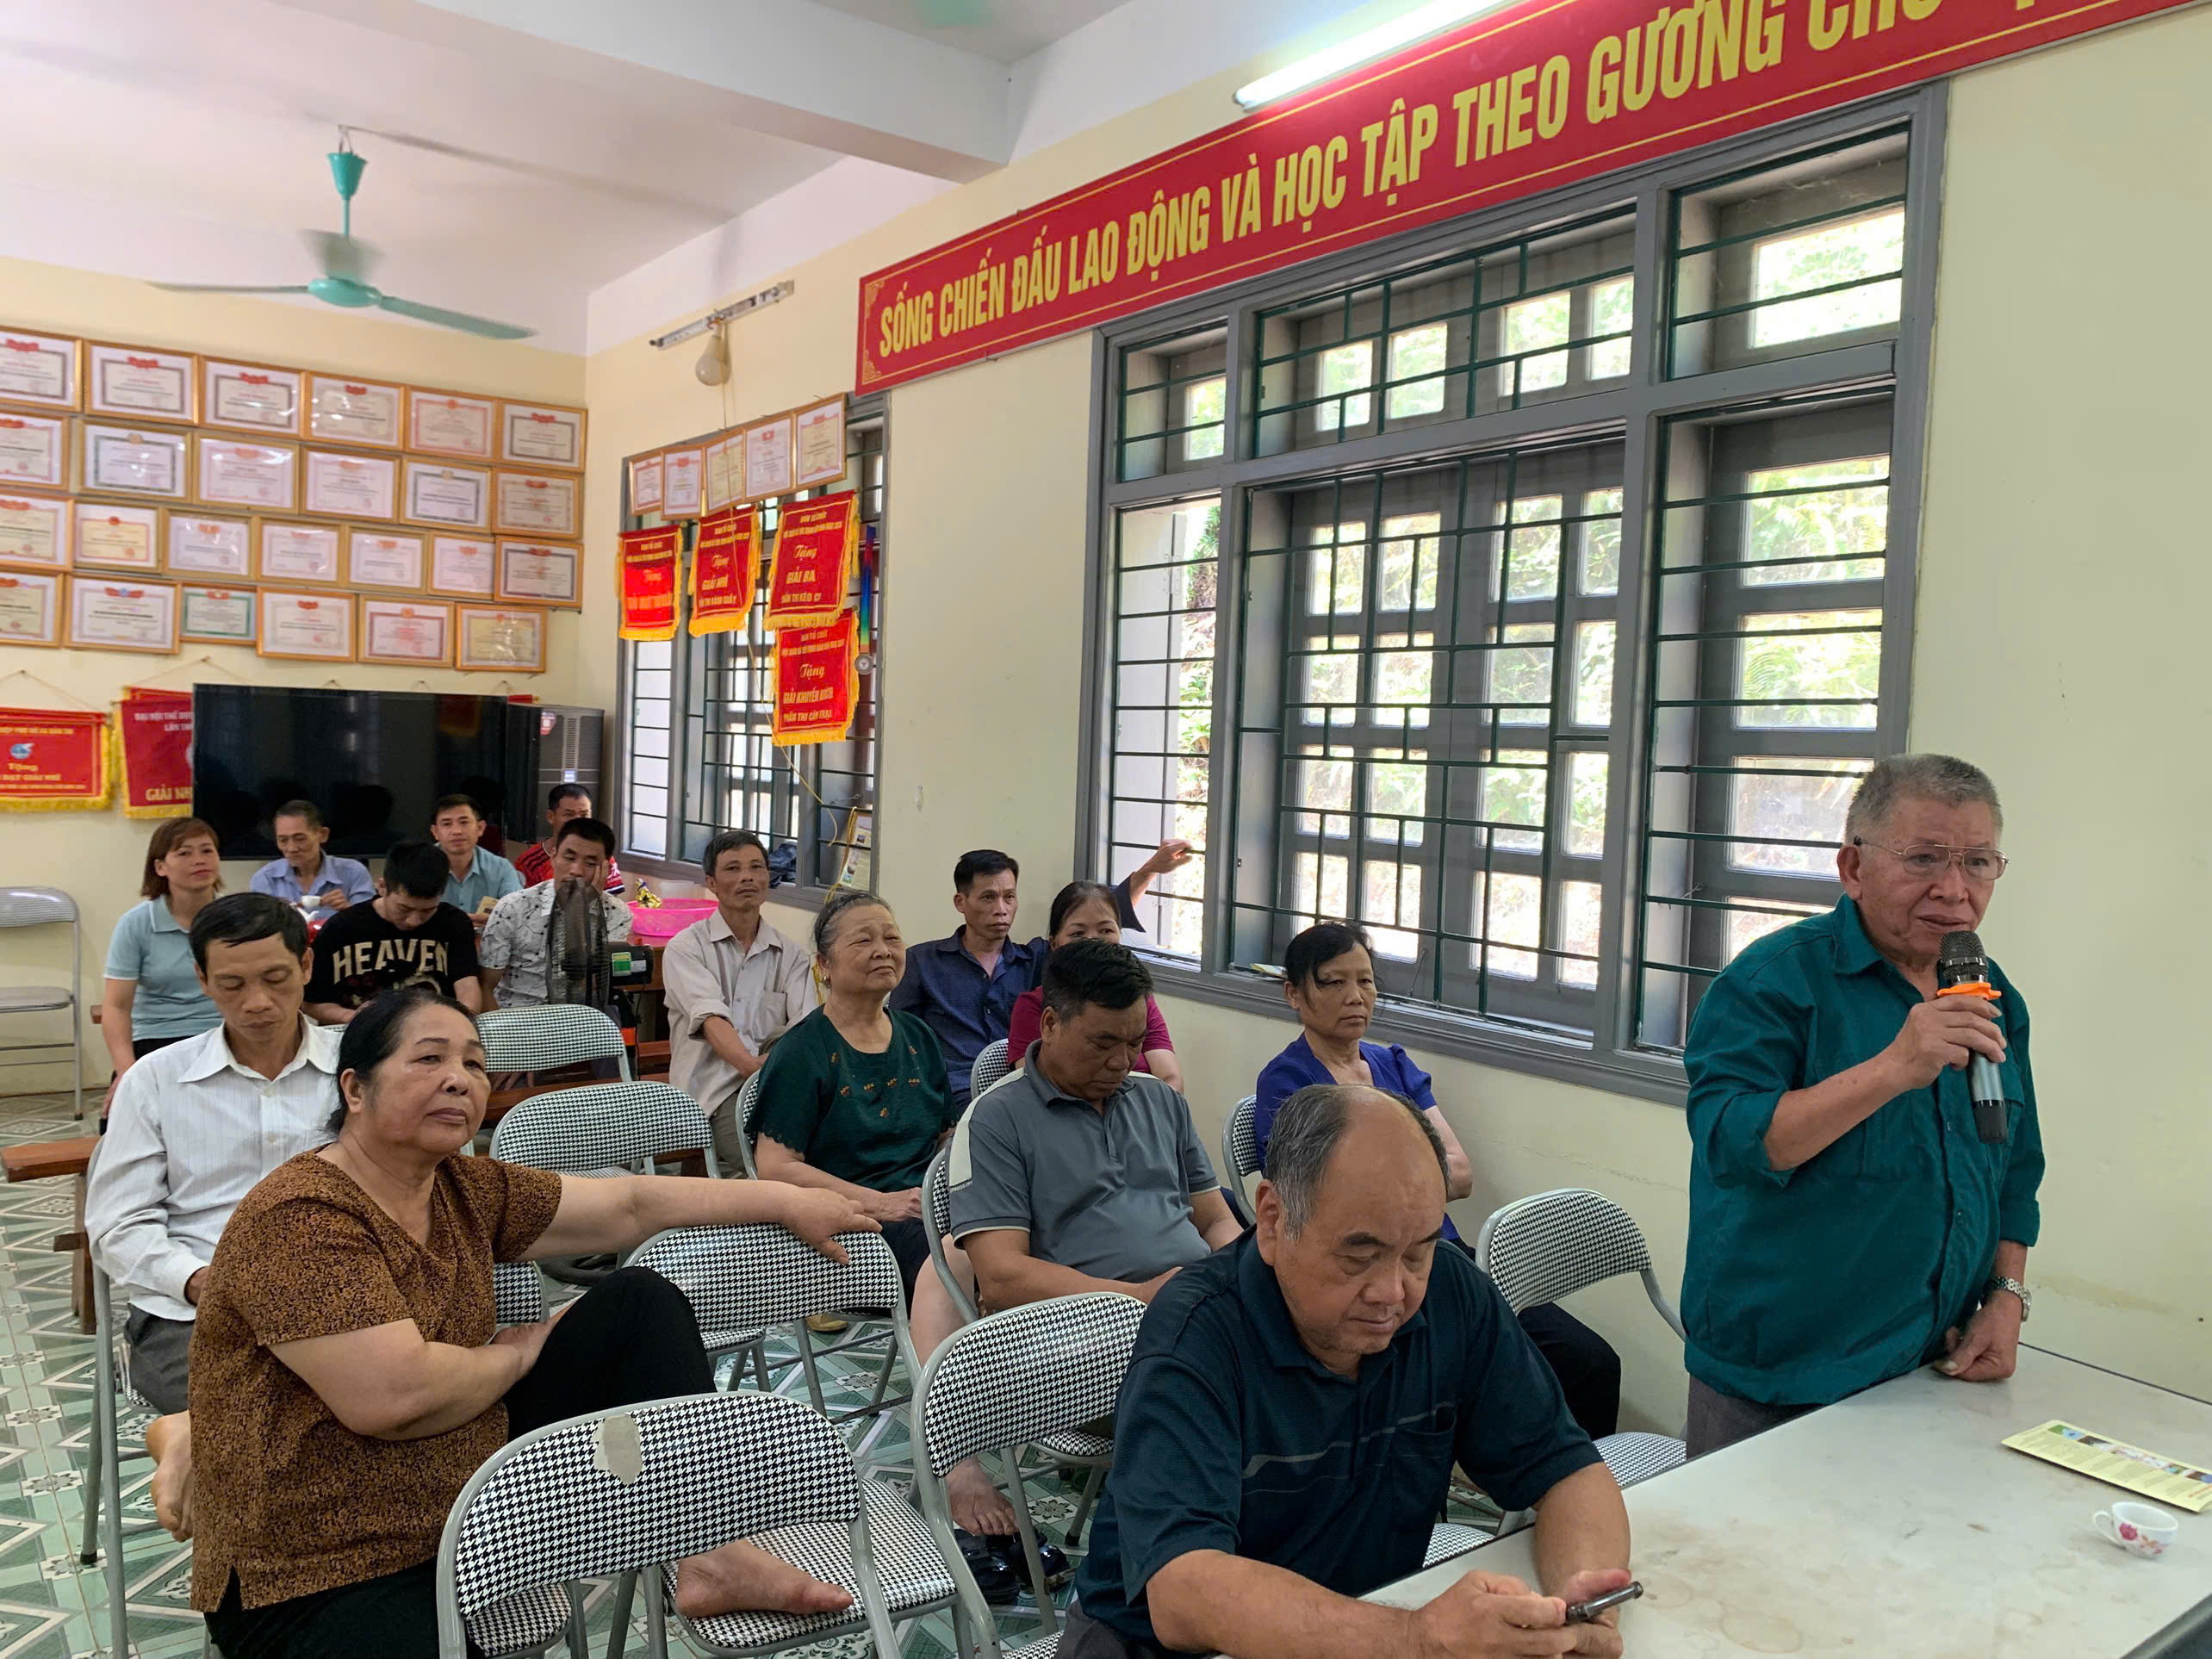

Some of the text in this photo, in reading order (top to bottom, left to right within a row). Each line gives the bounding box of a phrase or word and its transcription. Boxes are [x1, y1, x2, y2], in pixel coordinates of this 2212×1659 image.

[879, 282, 934, 357] SỐNG
[939, 247, 1006, 337] CHIẾN
[1011, 225, 1062, 314] ĐẤU
[1068, 221, 1120, 295] LAO
[1127, 189, 1210, 282] ĐỘNG
[1221, 152, 1261, 243] VÀ
[1272, 135, 1348, 233] HỌC
[1361, 97, 1438, 207] TẬP
[1452, 54, 1570, 167] THEO
[1587, 0, 1786, 124] GƯƠNG
[799, 663, 825, 680] Tặng
[145, 783, 172, 801] GIẢI
[332, 938, 448, 985] HEAVEN
